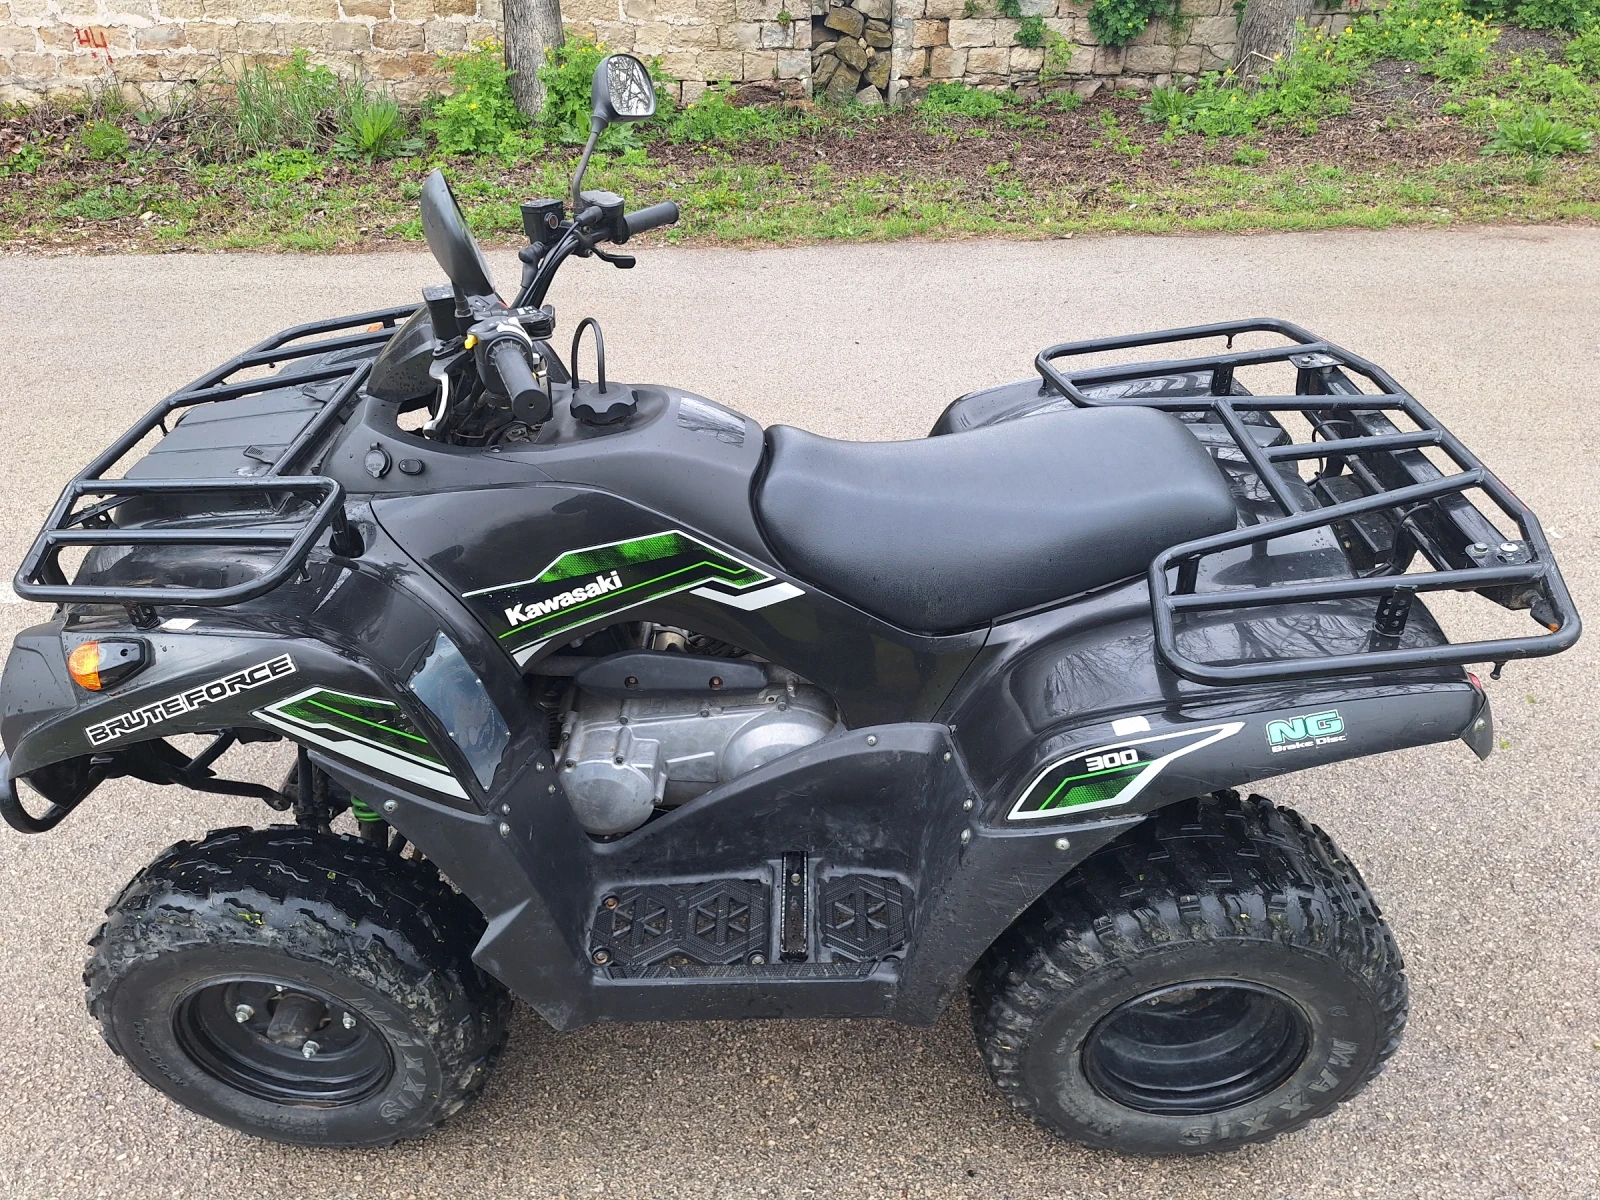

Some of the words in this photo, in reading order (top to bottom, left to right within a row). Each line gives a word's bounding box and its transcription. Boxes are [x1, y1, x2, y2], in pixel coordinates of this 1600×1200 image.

[504, 570, 623, 627] Kawasaki
[86, 695, 188, 746] BRUTE
[181, 653, 297, 711] FORCE
[1266, 709, 1345, 746] NG
[1085, 748, 1138, 772] 300
[1271, 741, 1314, 753] Brake
[1315, 735, 1347, 746] Disc
[344, 998, 427, 1125] MAXXIS
[1178, 1038, 1359, 1145] MAXXIS
